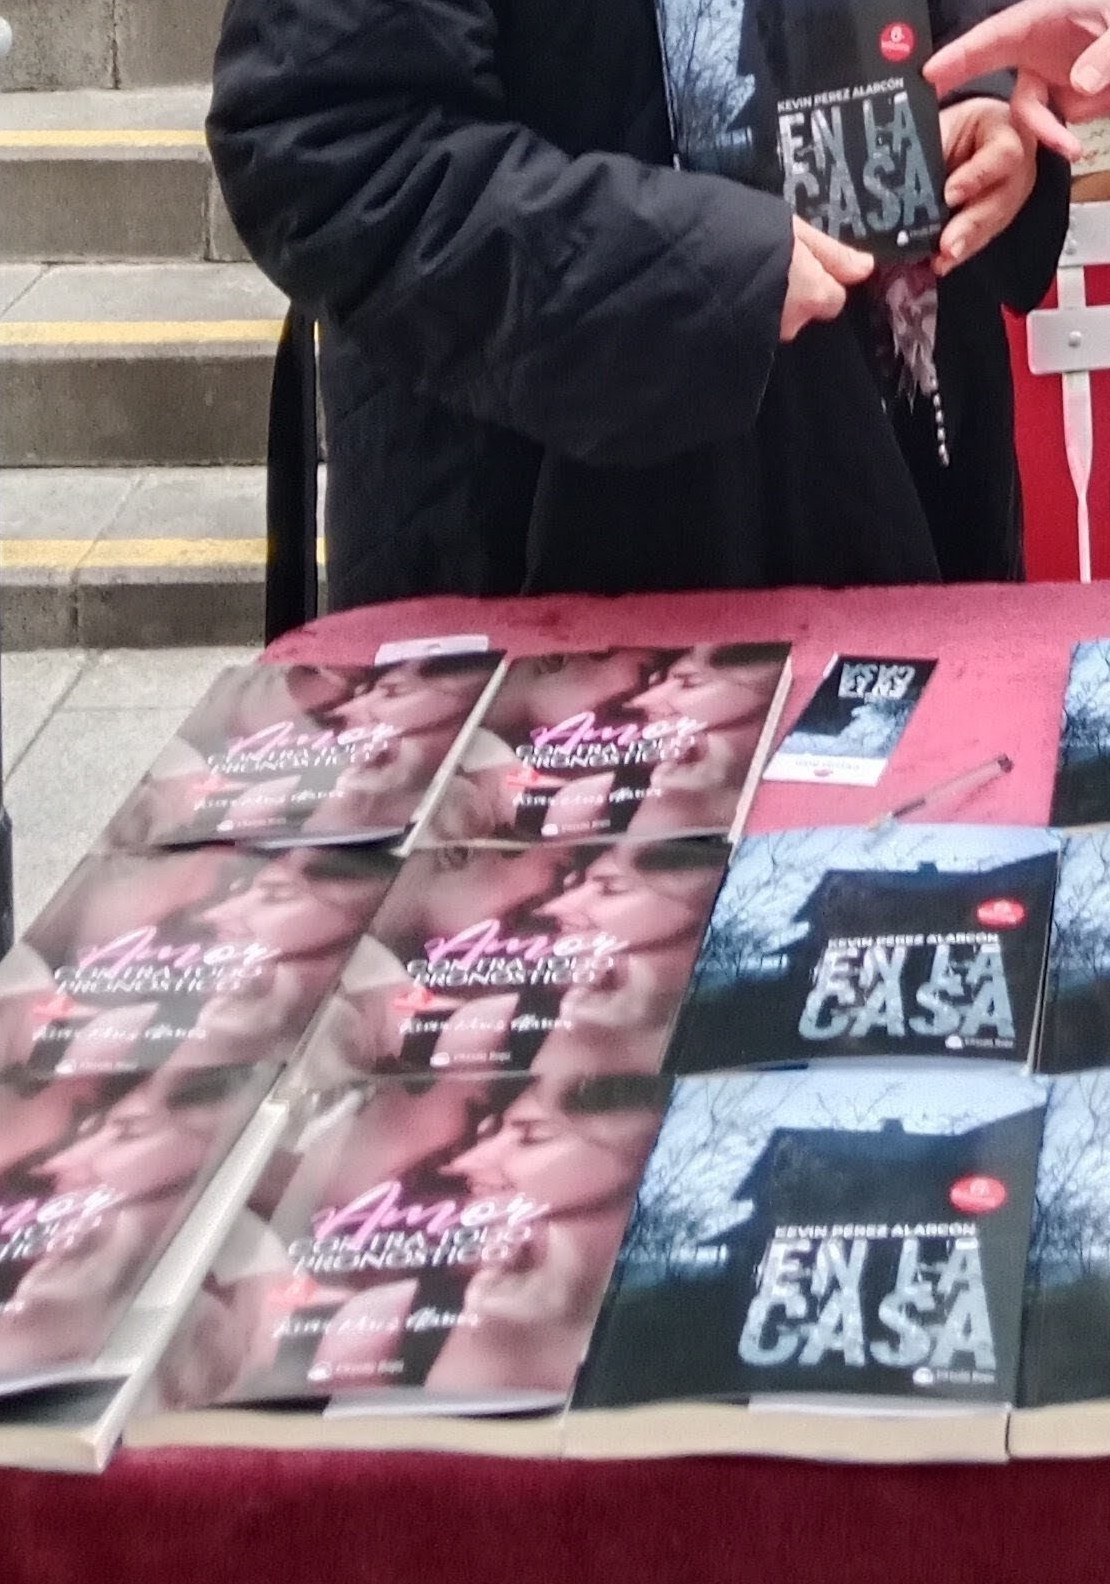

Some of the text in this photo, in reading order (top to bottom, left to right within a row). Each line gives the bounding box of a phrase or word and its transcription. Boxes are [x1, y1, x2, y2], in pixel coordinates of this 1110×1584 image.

[776, 95, 812, 114] KEVIN
[776, 91, 922, 173] EN LA
[783, 149, 942, 240] CASA
[424, 918, 630, 969] Amor
[811, 943, 1003, 996] EN LA
[799, 980, 1016, 1040] CASA
[311, 1181, 551, 1249] Amor
[774, 1224, 828, 1239] KEVIN
[753, 1236, 985, 1310] EN LA
[738, 1288, 997, 1367] CASA
